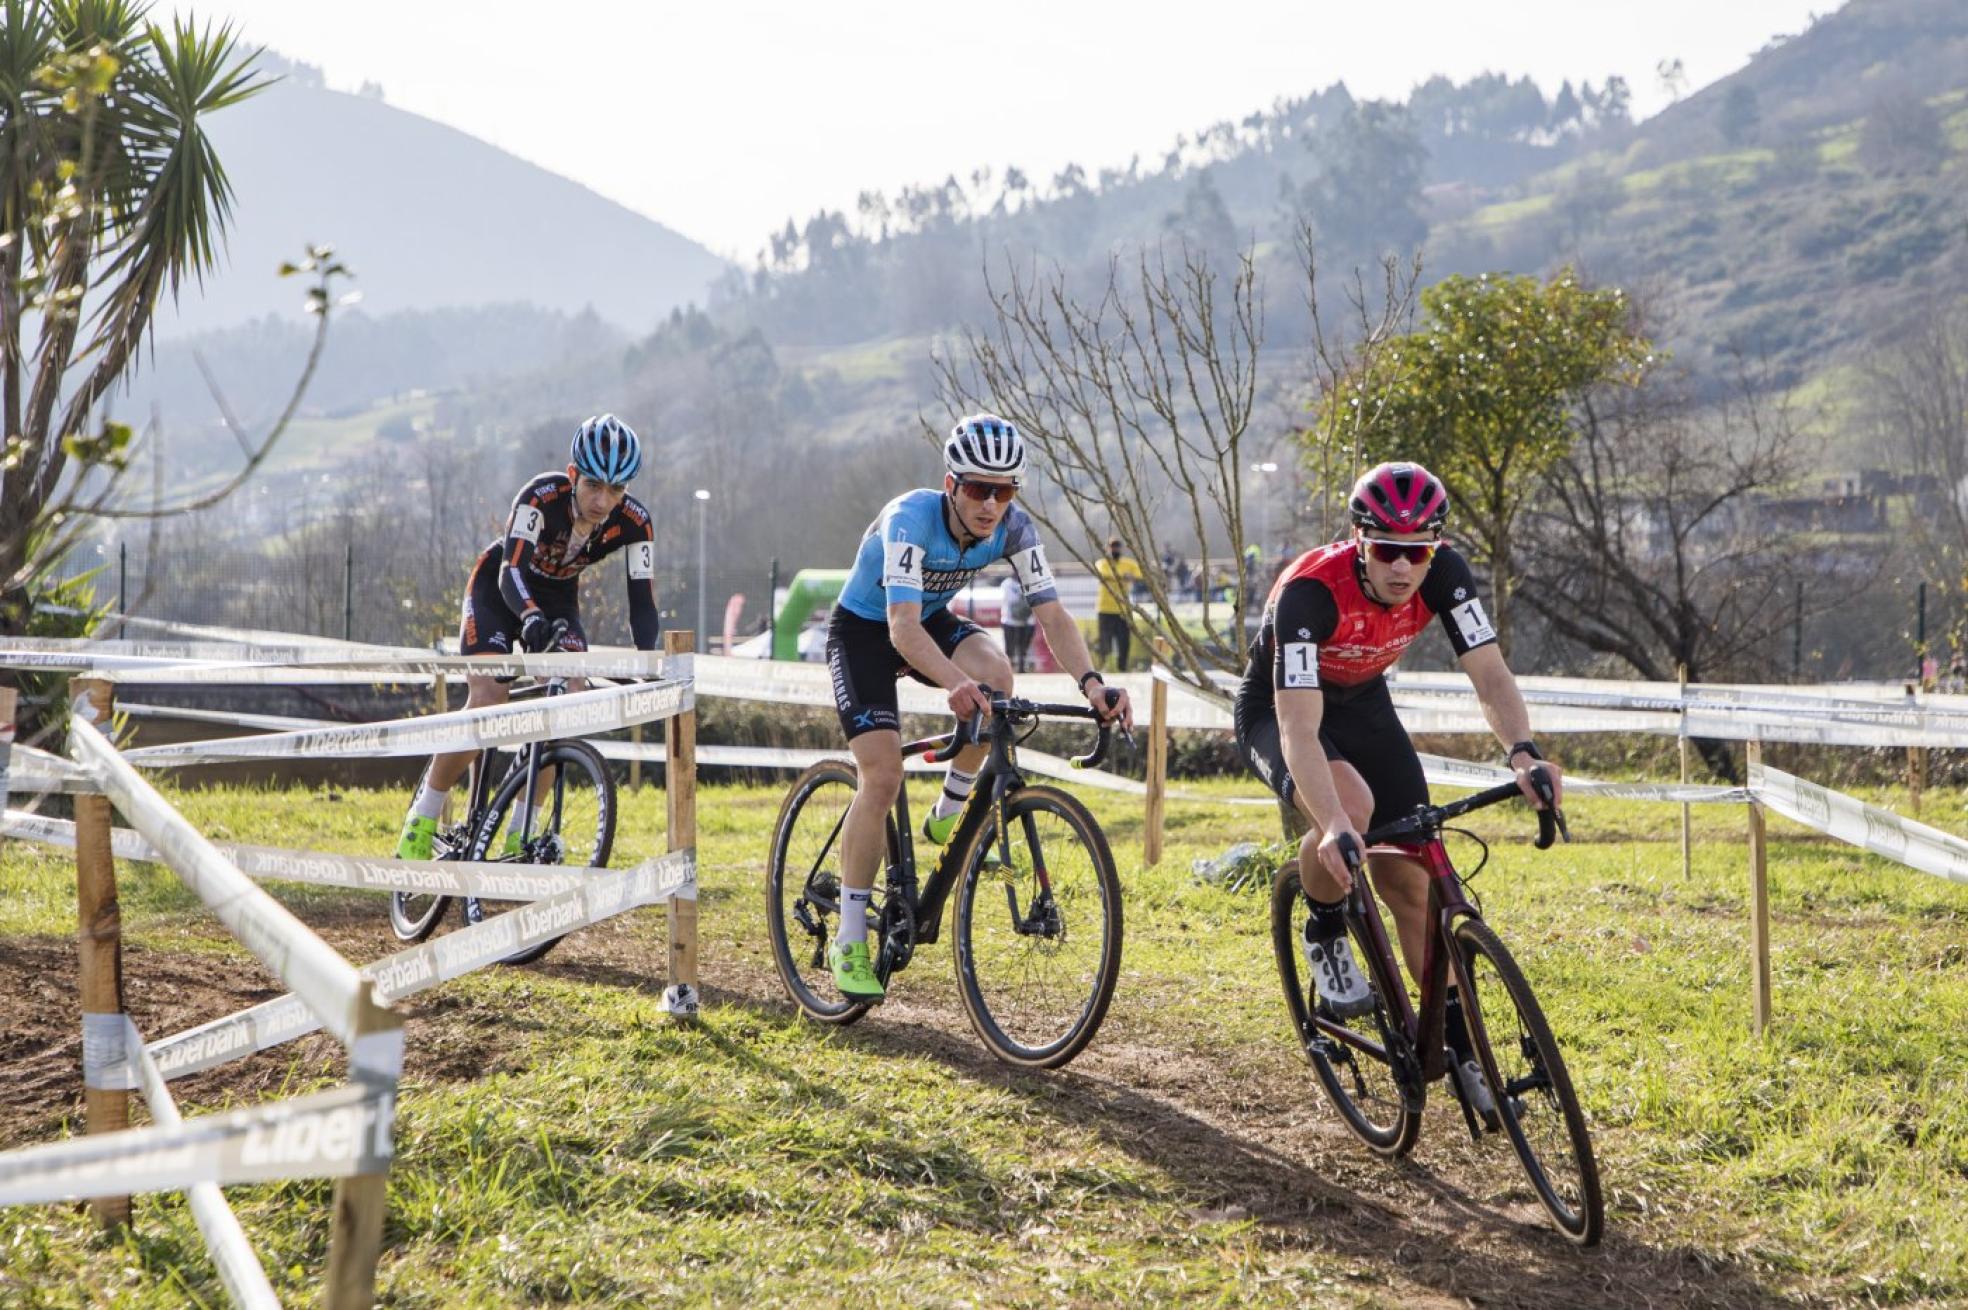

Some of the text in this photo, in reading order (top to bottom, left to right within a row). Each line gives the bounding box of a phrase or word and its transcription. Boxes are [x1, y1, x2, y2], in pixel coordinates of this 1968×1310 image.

[527, 511, 539, 532] 3
[641, 545, 650, 568] 3
[899, 546, 913, 574] 4
[1031, 550, 1043, 577] 4
[1464, 603, 1482, 627] 1
[1296, 645, 1308, 672] 1
[624, 686, 683, 717] Liberbank
[478, 709, 545, 740] Liberbank
[362, 863, 460, 890] Liberbank
[519, 894, 584, 940] Liberbank
[158, 1018, 250, 1070] Liberbank
